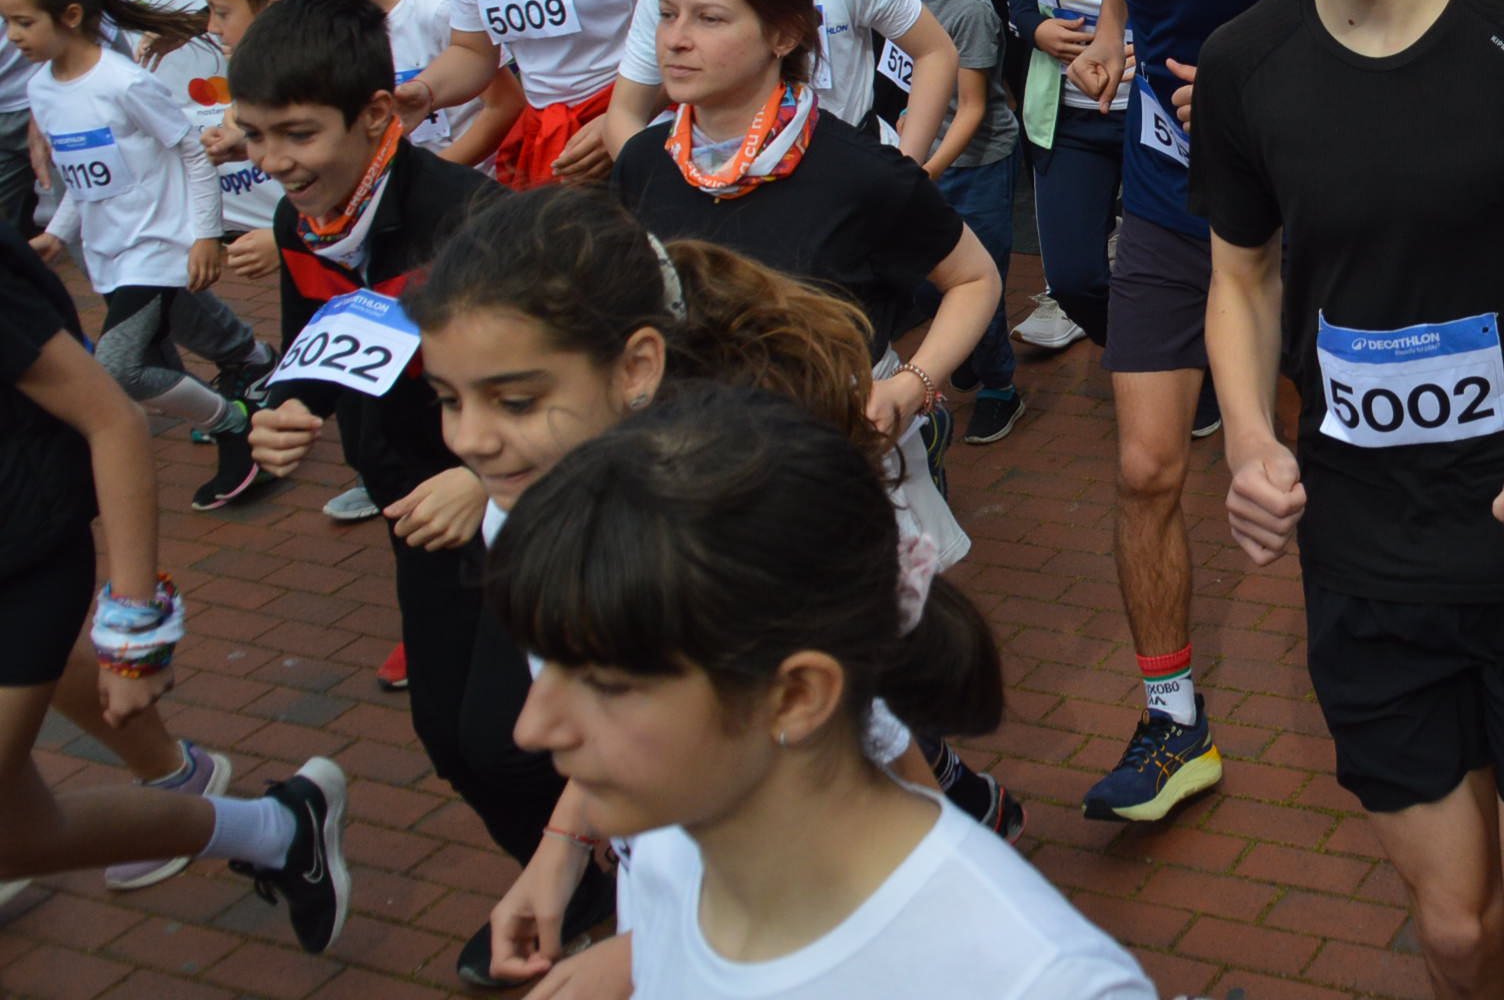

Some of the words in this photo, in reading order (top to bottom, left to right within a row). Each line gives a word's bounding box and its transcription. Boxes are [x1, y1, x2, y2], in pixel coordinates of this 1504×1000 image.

[279, 330, 393, 383] 5022
[1368, 332, 1440, 351] DECATHLON
[1330, 375, 1495, 433] 5002
